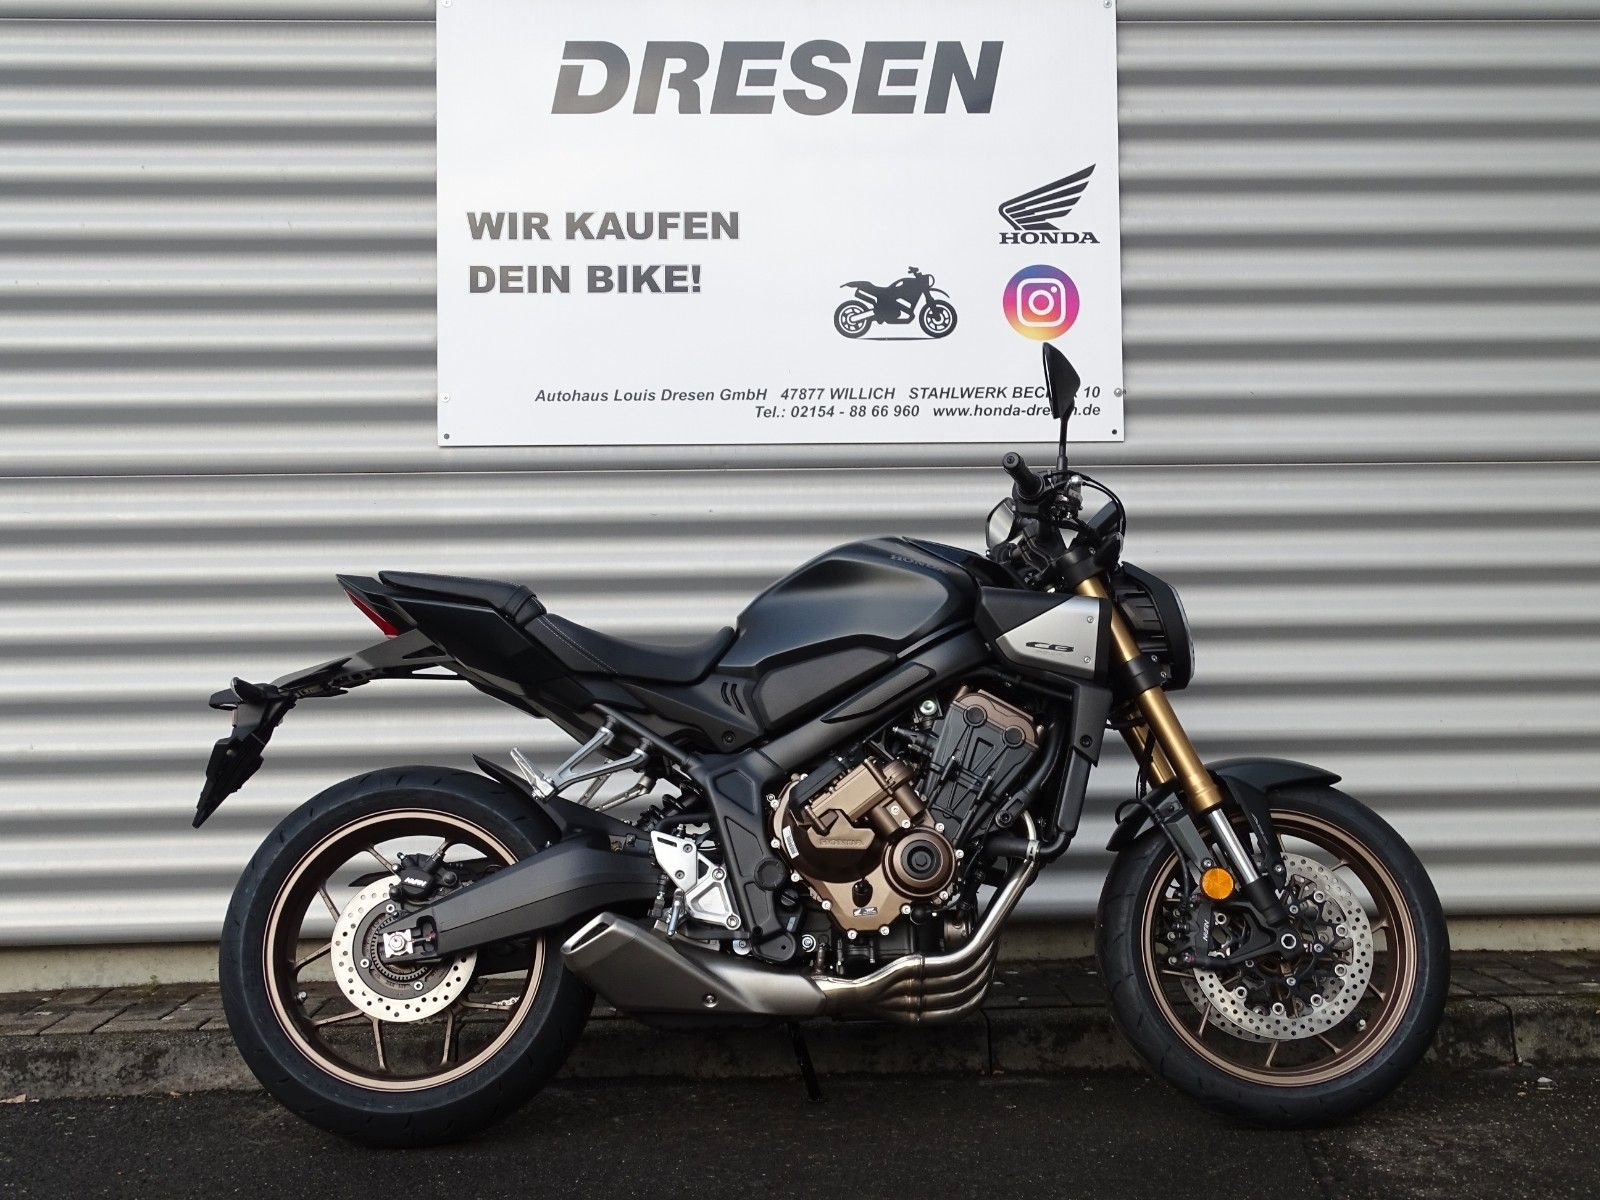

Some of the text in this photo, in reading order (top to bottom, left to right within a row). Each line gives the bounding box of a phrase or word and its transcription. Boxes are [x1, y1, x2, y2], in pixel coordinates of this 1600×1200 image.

[552, 40, 1003, 115] DRESEN
[467, 211, 739, 240] WIR KAUFEN
[999, 232, 1100, 245] HONDA
[470, 264, 702, 294] DEIN BIKE!
[535, 389, 608, 402] Autohaus
[614, 389, 655, 402] Louis
[661, 388, 715, 401] Dresen
[720, 388, 767, 401] GmbH
[781, 388, 824, 400] 47877
[830, 387, 895, 400] WILLICH
[909, 386, 1007, 400] STAHLWERK
[1084, 386, 1100, 399] 10
[755, 406, 785, 418] Tel.:
[791, 405, 835, 418] 02154
[850, 405, 866, 417] 88
[872, 405, 888, 417] 66
[894, 404, 919, 417] 960
[1026, 641, 1074, 652] CB
